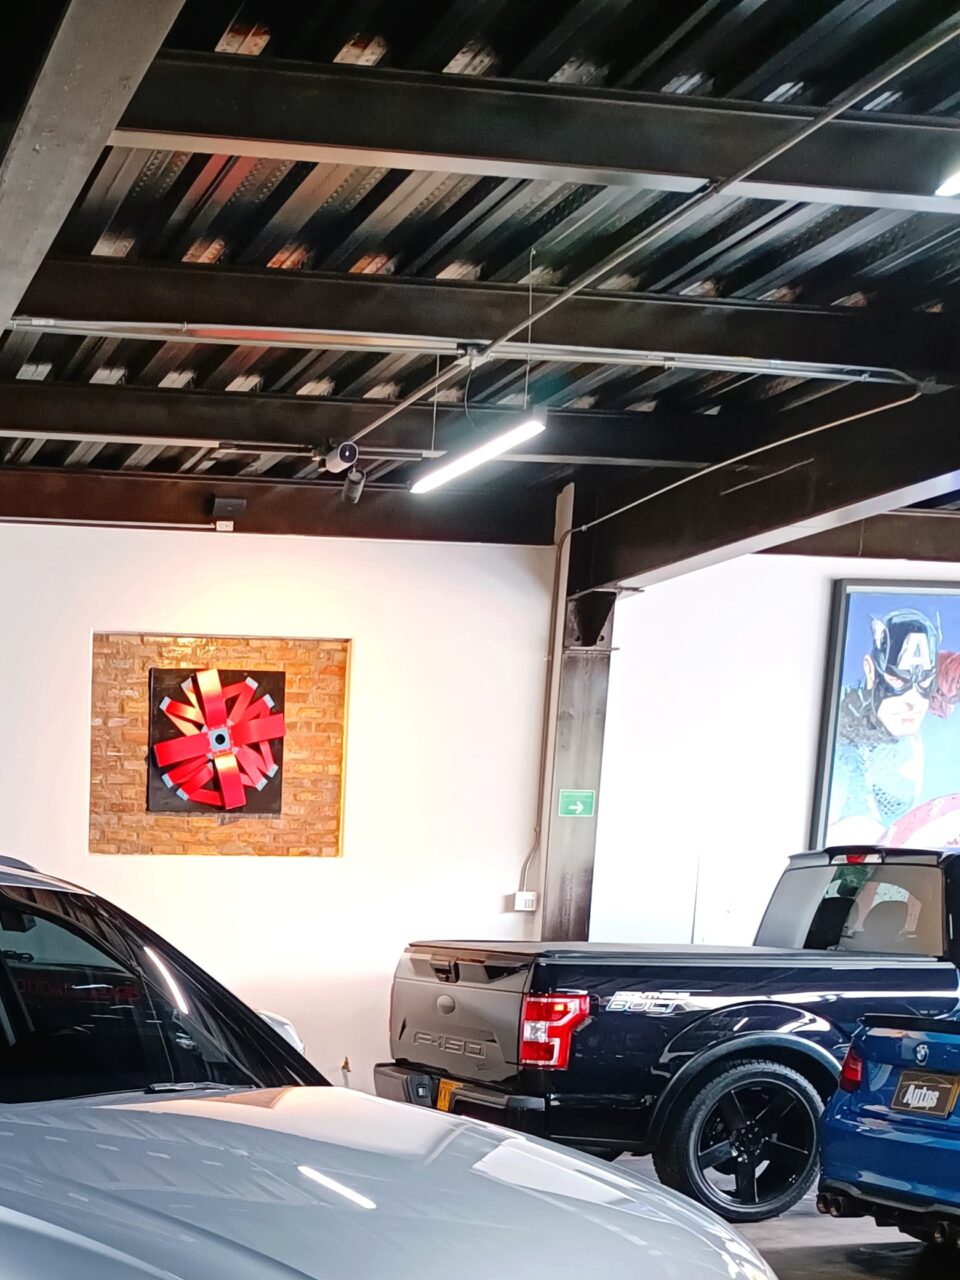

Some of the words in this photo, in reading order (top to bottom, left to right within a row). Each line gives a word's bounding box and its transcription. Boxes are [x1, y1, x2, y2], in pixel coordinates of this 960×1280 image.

[897, 632, 932, 671] A
[605, 1000, 677, 1013] BOLT
[414, 1031, 487, 1059] F-150
[903, 1084, 940, 1107] Autos
